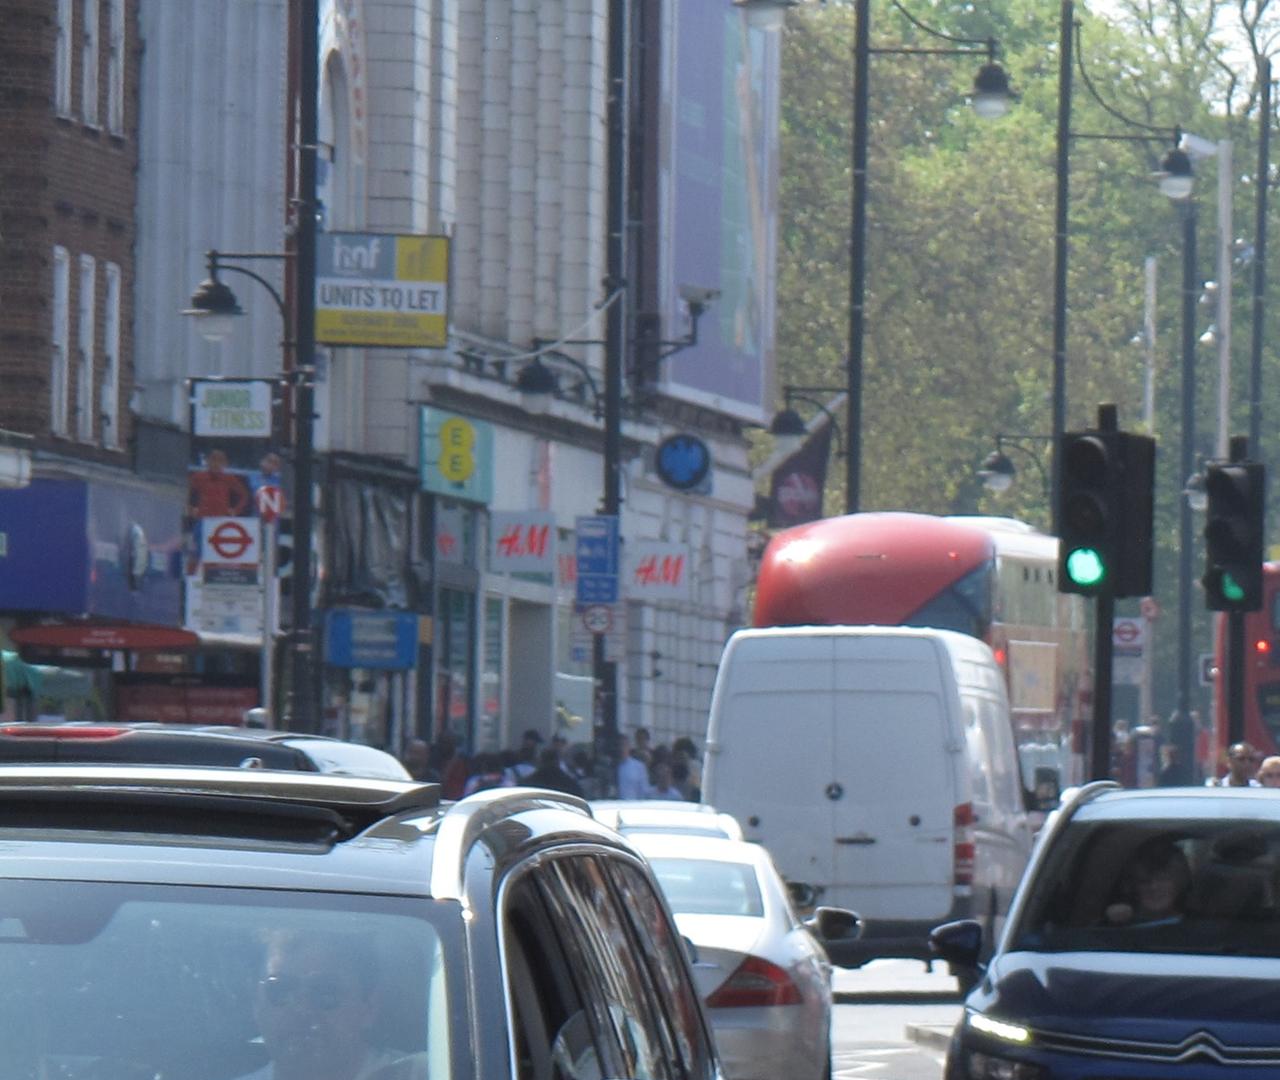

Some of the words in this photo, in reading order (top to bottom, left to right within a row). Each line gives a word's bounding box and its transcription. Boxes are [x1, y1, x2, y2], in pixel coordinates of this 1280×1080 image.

[320, 283, 375, 307] UNITS
[381, 287, 403, 309] TO
[408, 288, 439, 311] LET
